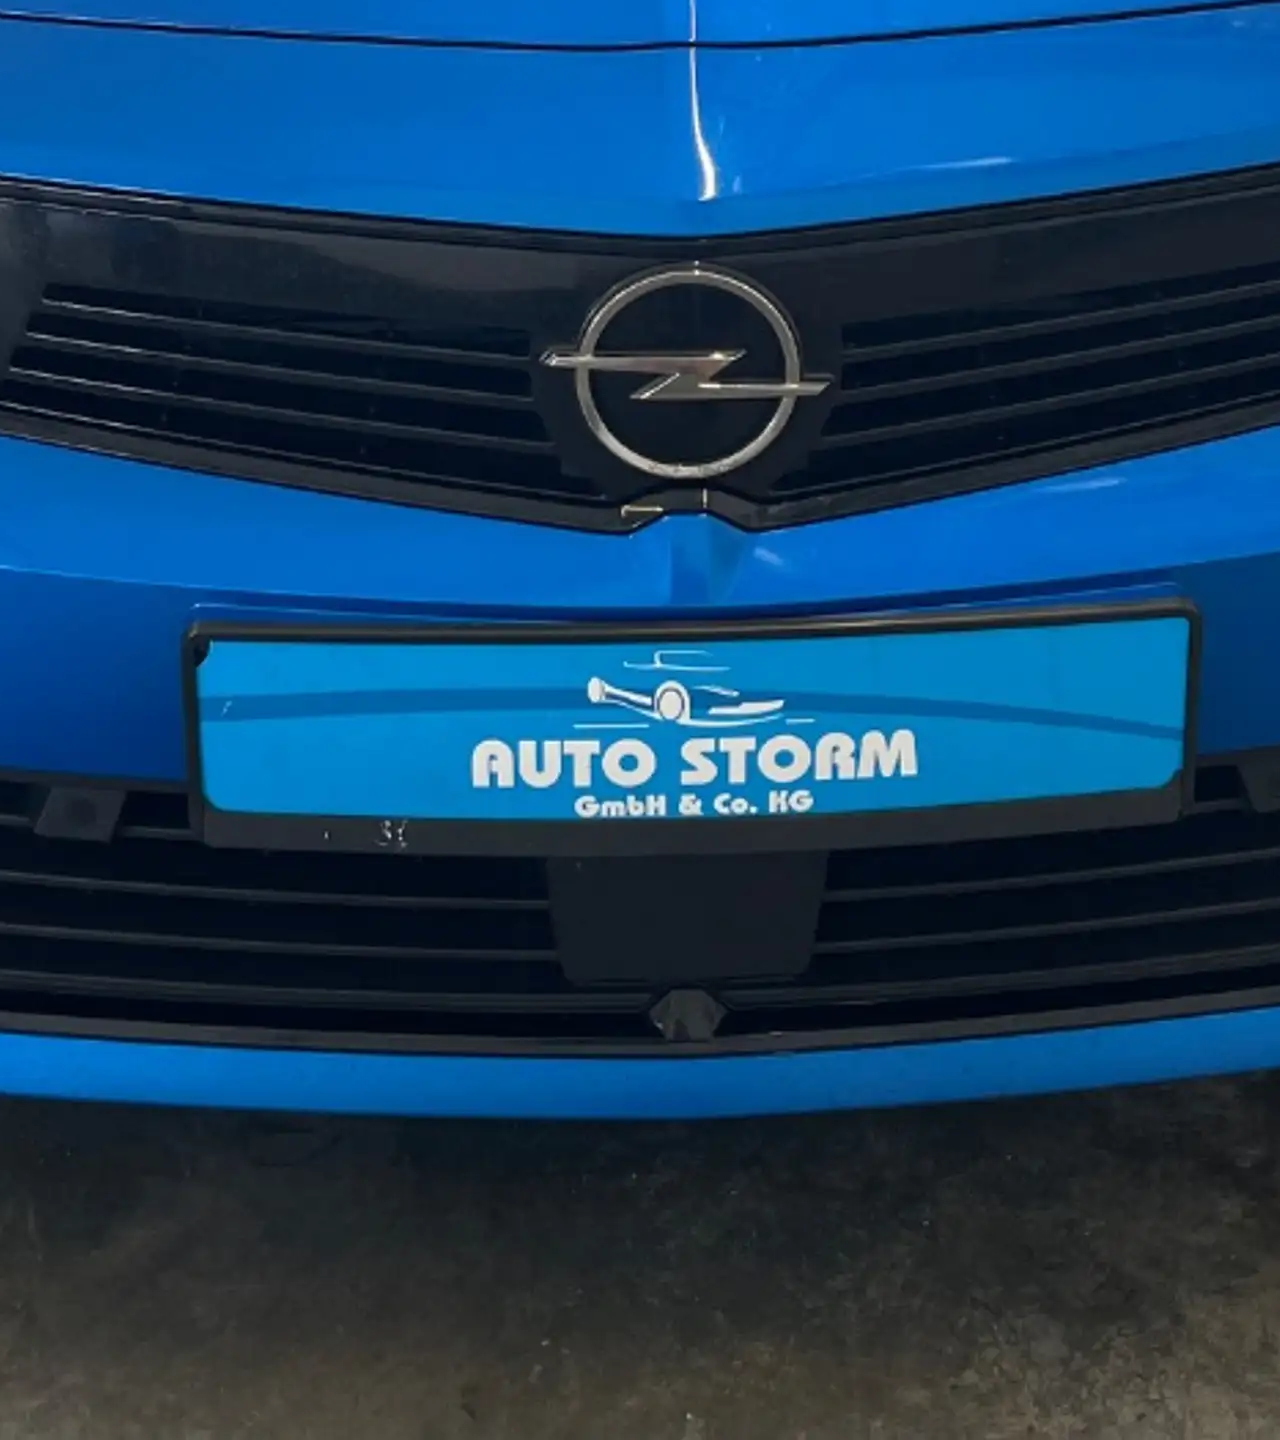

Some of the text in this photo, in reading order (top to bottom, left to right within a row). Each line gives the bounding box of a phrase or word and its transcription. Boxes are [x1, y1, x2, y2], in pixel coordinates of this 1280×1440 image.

[472, 728, 918, 789] AUTO STORM
[573, 794, 667, 818] GmbH
[678, 792, 704, 816] &
[713, 792, 759, 815] Co.
